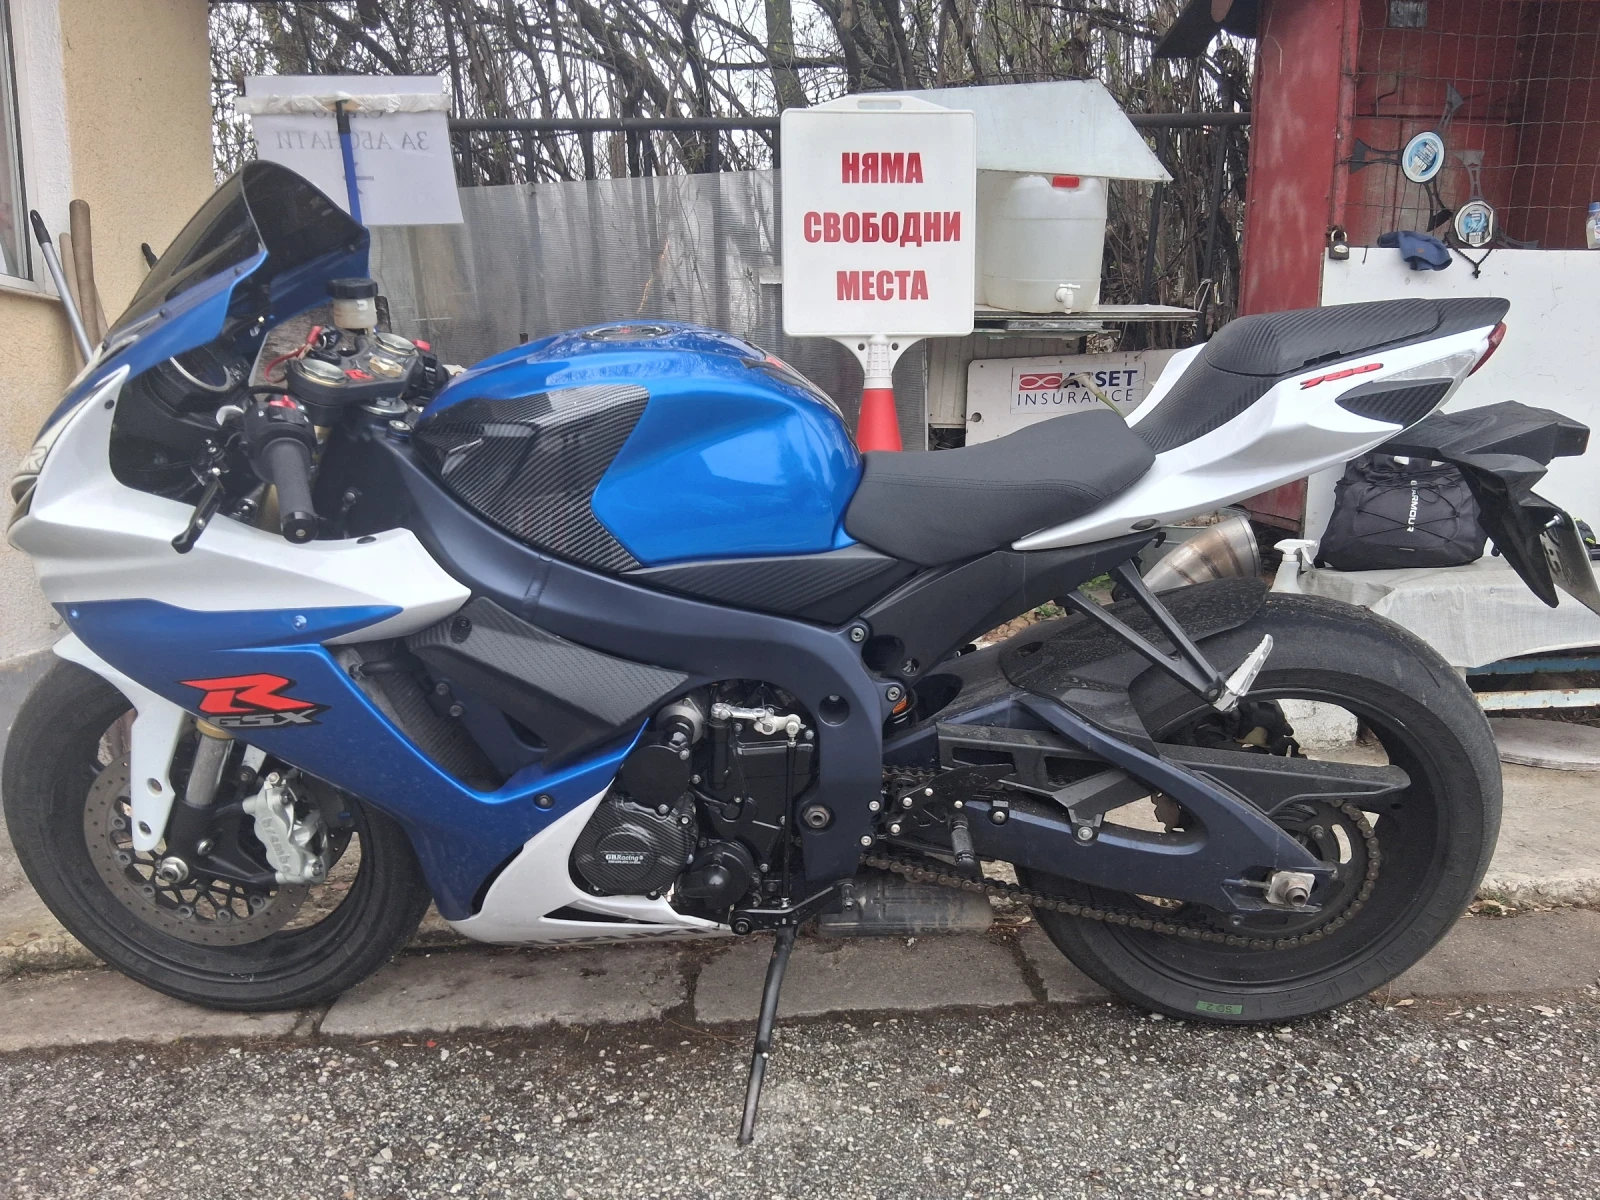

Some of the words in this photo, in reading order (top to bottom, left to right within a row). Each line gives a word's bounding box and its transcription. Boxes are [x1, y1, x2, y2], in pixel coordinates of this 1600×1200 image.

[841, 152, 924, 184] НЯМА
[803, 210, 962, 248] СВОБОДНИ
[836, 269, 929, 301] МЕСТА
[1063, 369, 1138, 389] ASET
[176, 672, 325, 715] R
[207, 708, 319, 728] GSX
